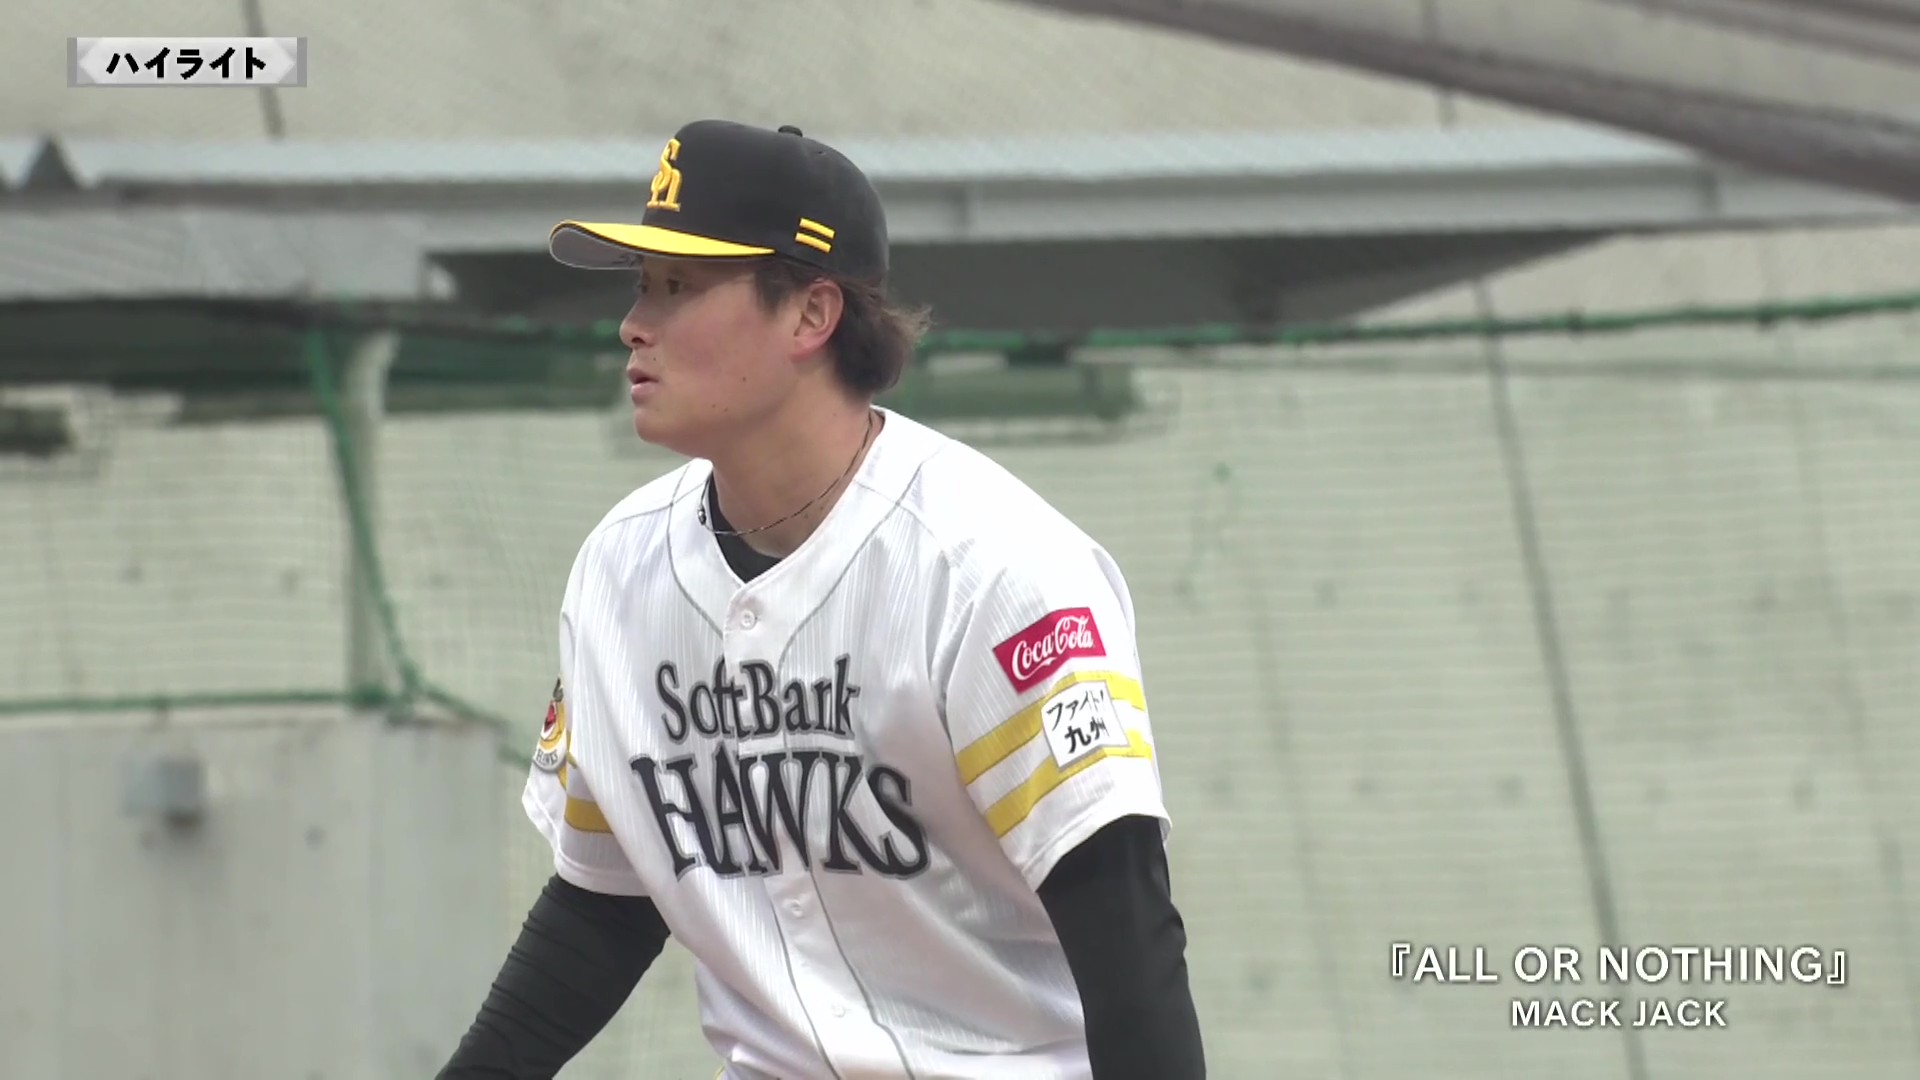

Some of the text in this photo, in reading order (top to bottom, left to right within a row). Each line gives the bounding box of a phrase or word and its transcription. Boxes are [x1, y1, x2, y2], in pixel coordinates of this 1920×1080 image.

[655, 653, 861, 744] SoftBank
[1064, 716, 1110, 754] 九州
[629, 742, 932, 881] HAWKS
